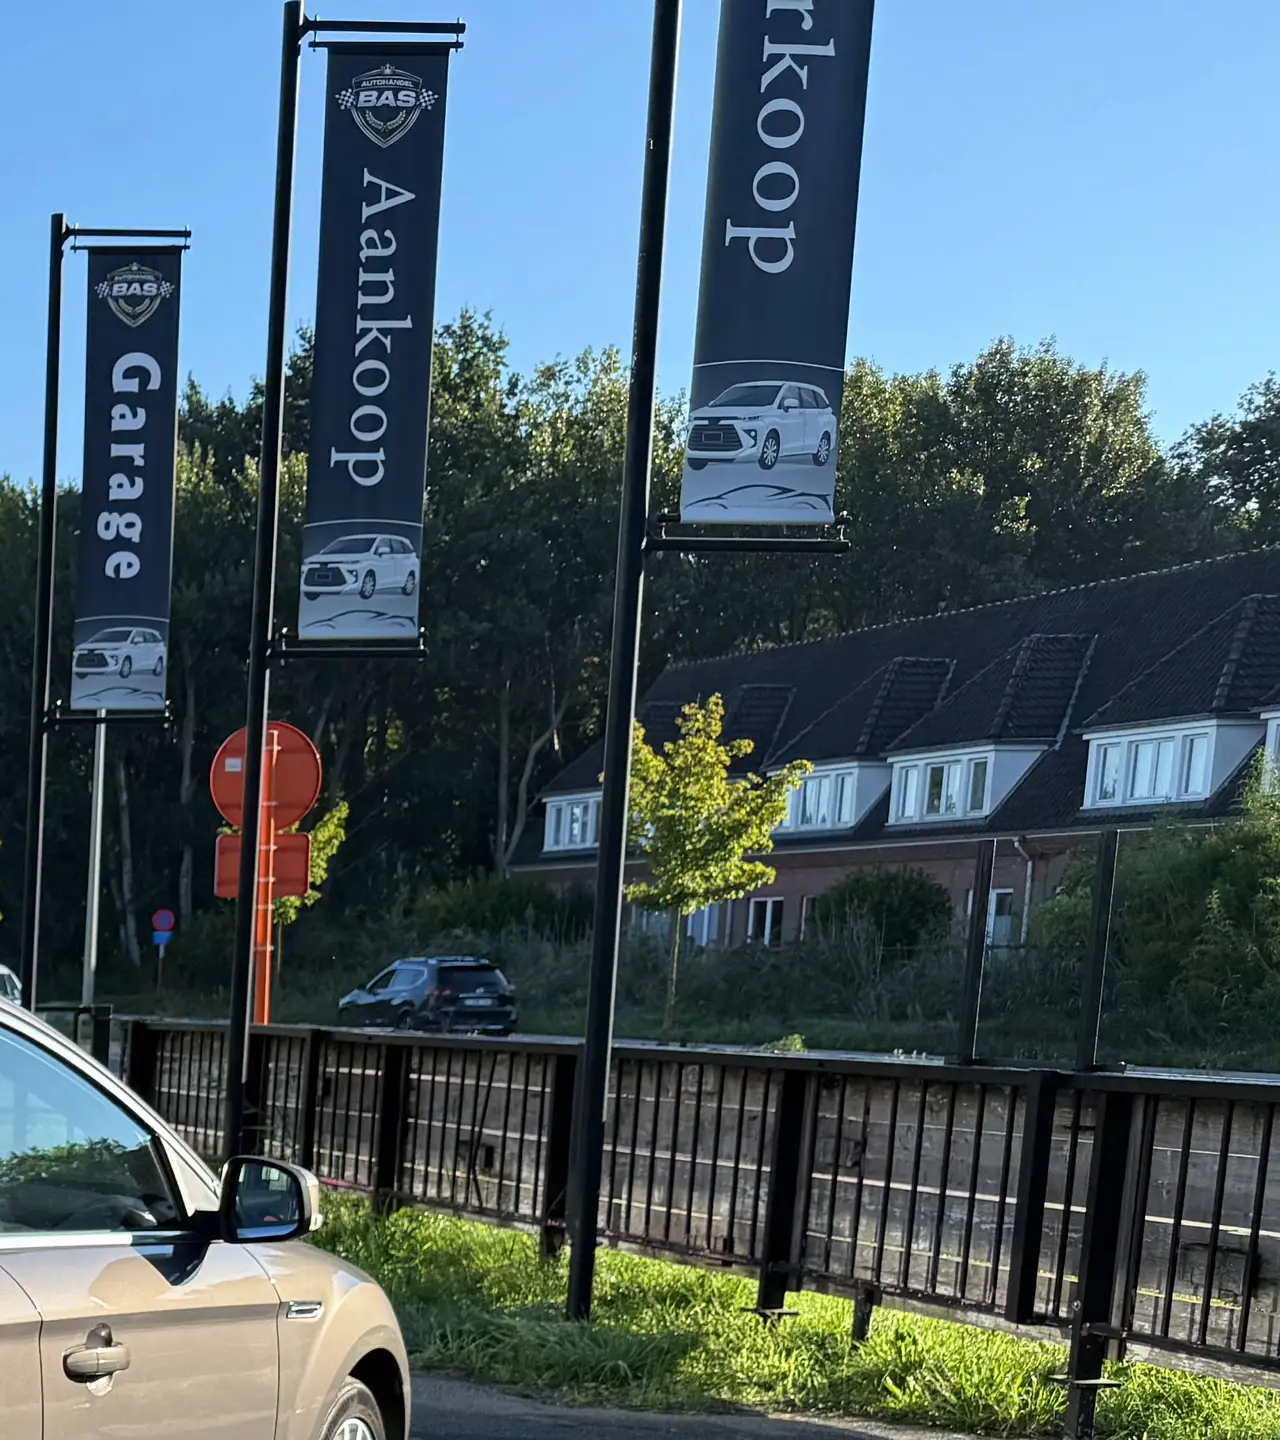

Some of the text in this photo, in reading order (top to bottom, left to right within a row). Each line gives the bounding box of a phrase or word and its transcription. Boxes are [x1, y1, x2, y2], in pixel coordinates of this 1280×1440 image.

[360, 79, 415, 88] AUTOHANDEL
[357, 90, 417, 107] BAS
[112, 282, 158, 296] BAS
[330, 167, 416, 487] Aankoop
[97, 351, 162, 580] Garage
